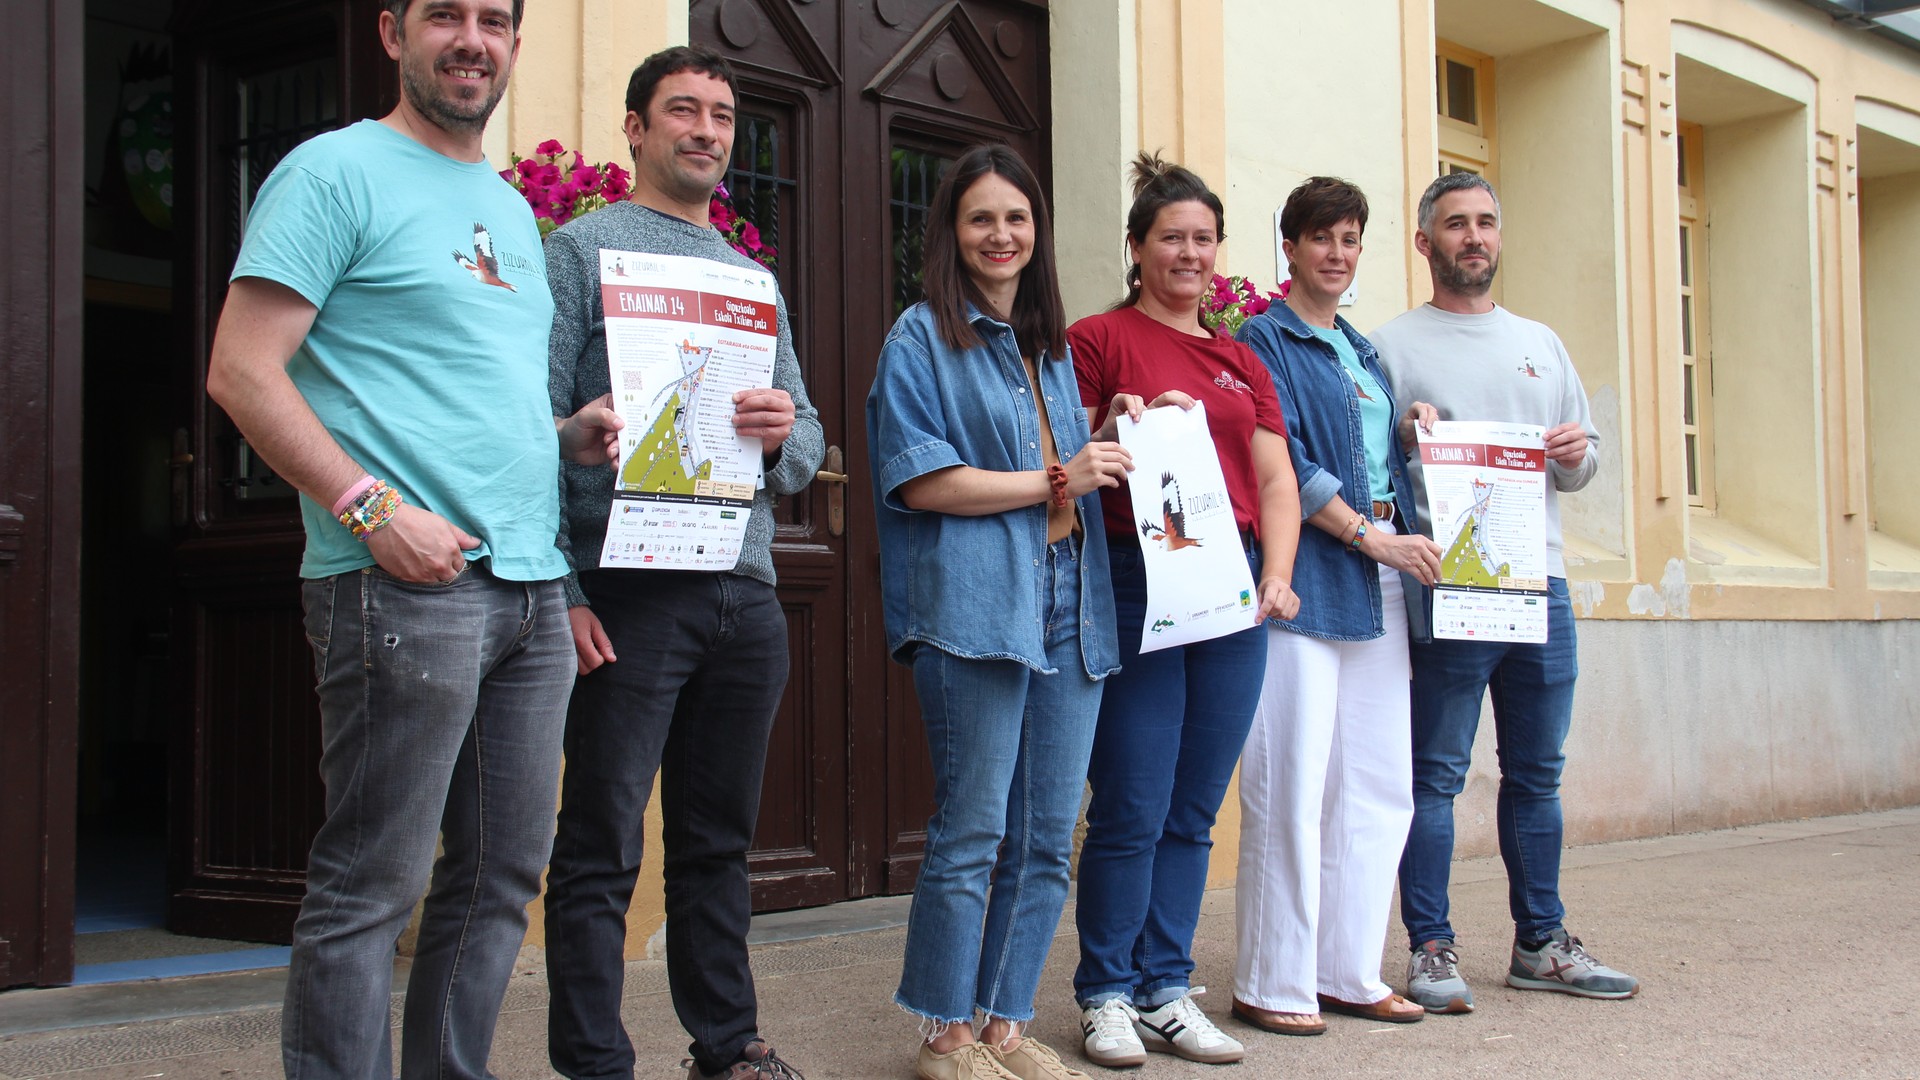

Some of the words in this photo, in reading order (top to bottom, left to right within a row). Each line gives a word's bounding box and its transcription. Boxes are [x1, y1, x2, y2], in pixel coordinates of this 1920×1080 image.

[619, 293, 668, 314] EKAINAK
[671, 296, 685, 316] 14
[726, 300, 756, 315] Gipuzkoako
[715, 310, 733, 324] Eskola
[733, 313, 753, 328] Txikien
[1430, 447, 1464, 461] EKAINAK
[1465, 448, 1476, 462] 14
